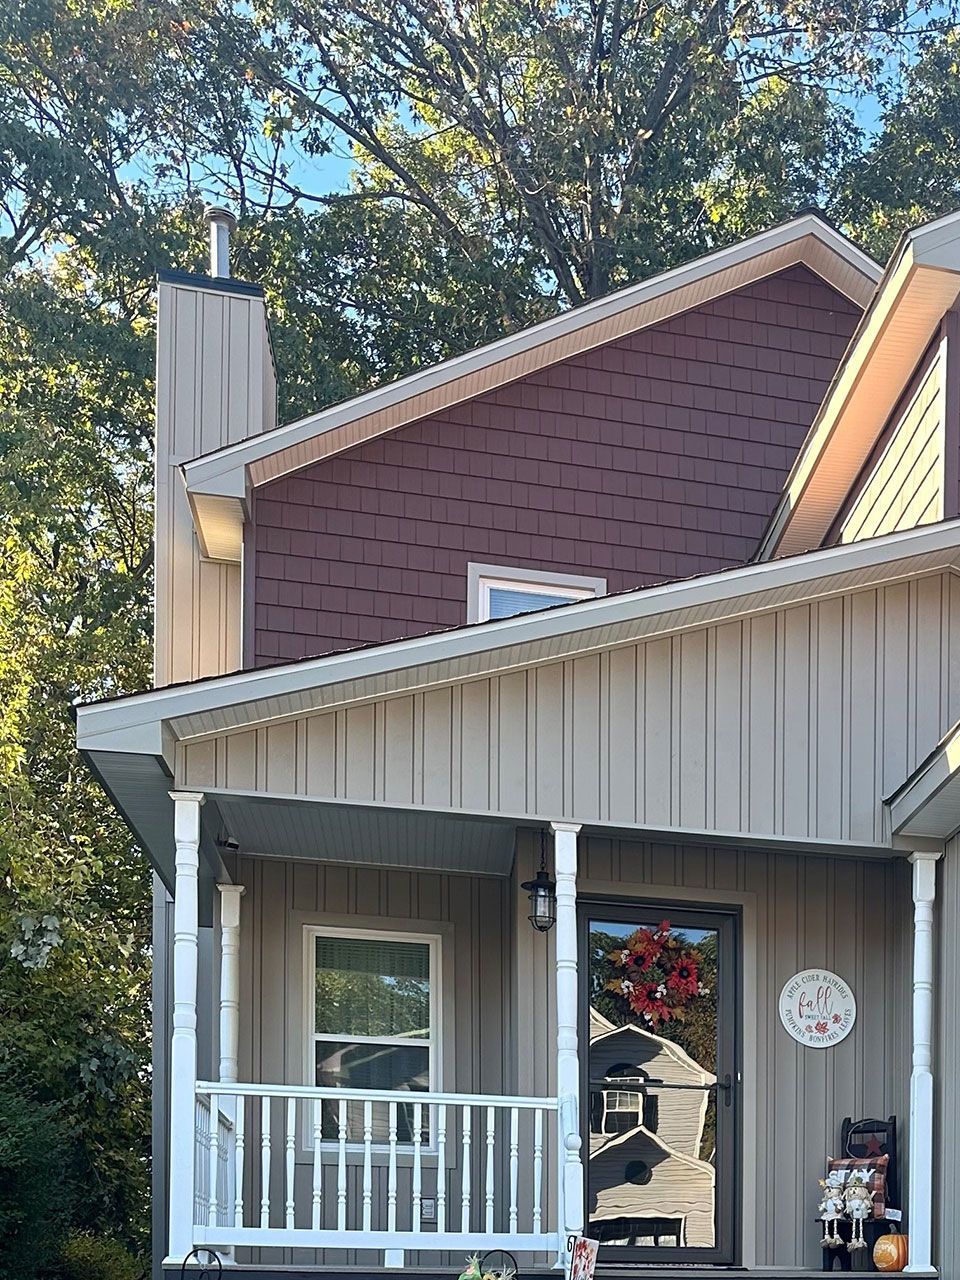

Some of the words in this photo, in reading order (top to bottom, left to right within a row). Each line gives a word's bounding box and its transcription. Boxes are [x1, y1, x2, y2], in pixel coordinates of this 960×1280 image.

[802, 974, 819, 984] CIDER
[822, 975, 848, 999] HAYRIDES
[798, 986, 833, 1019] fall
